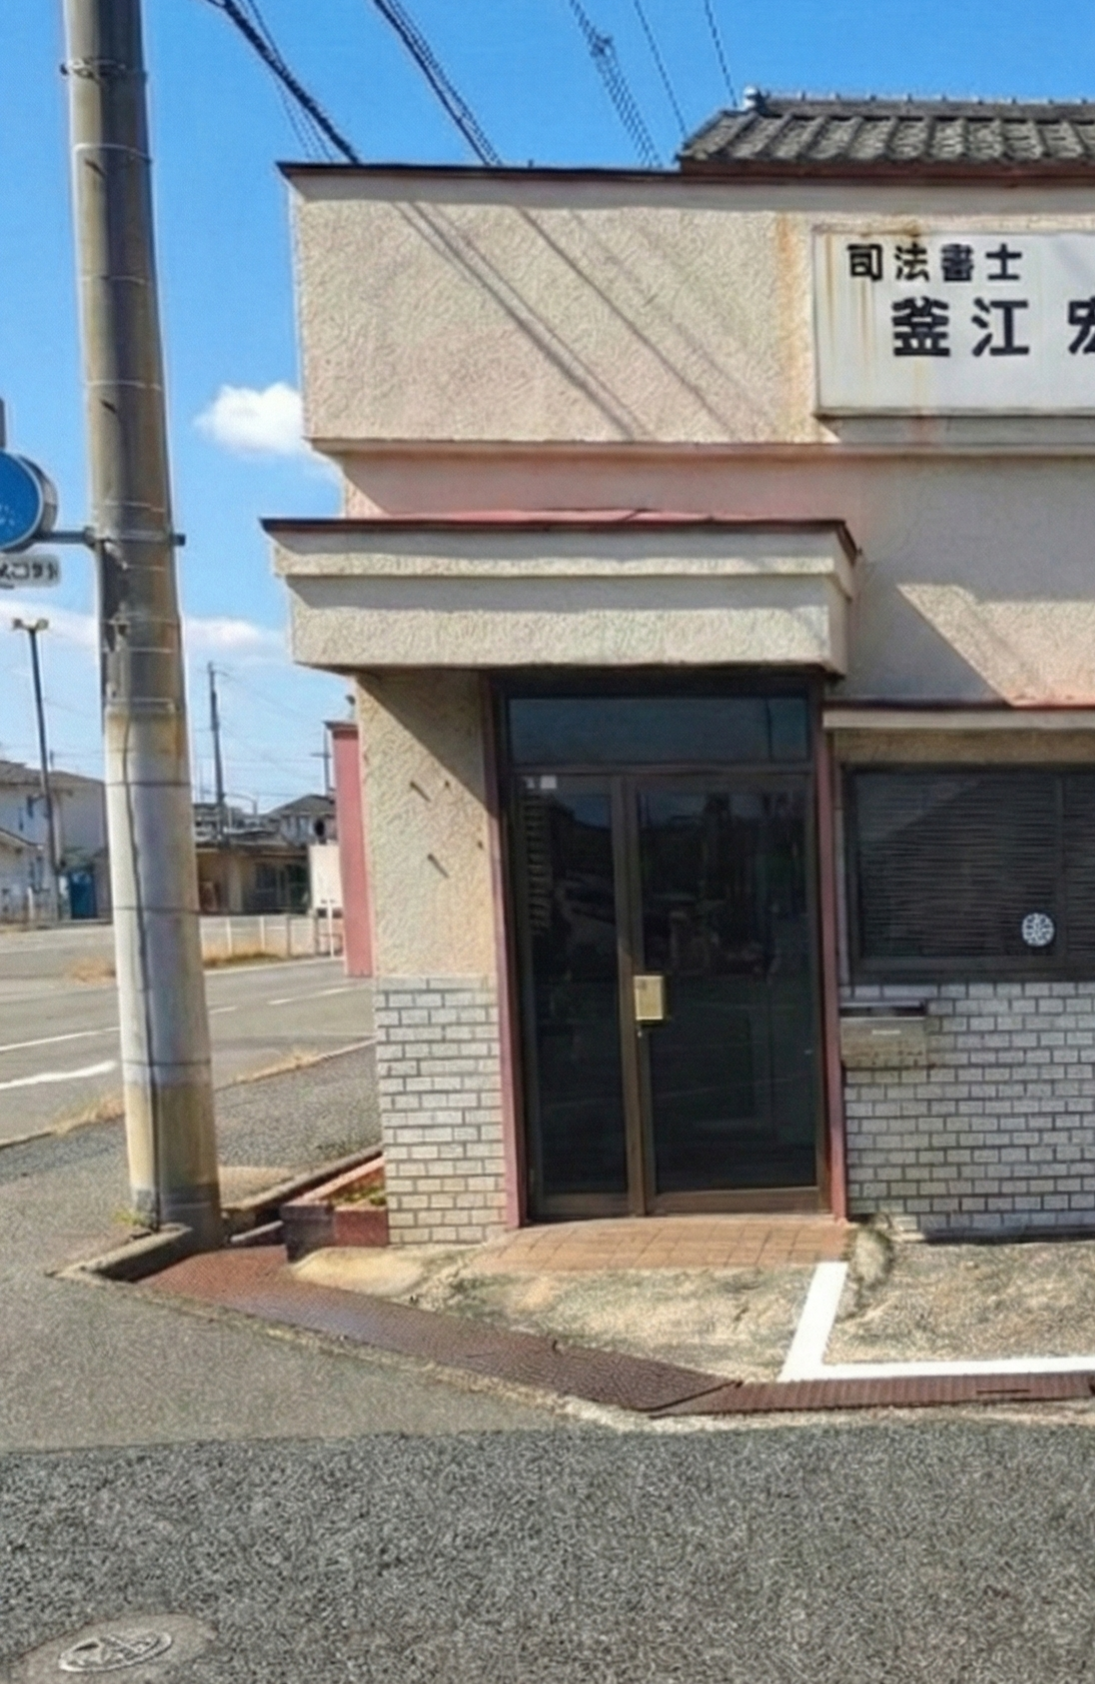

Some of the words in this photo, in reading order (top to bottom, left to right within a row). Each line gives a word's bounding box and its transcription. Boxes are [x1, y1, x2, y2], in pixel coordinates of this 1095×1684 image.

[847, 241, 1023, 283] 司法書士
[891, 297, 1030, 358] 釜江
